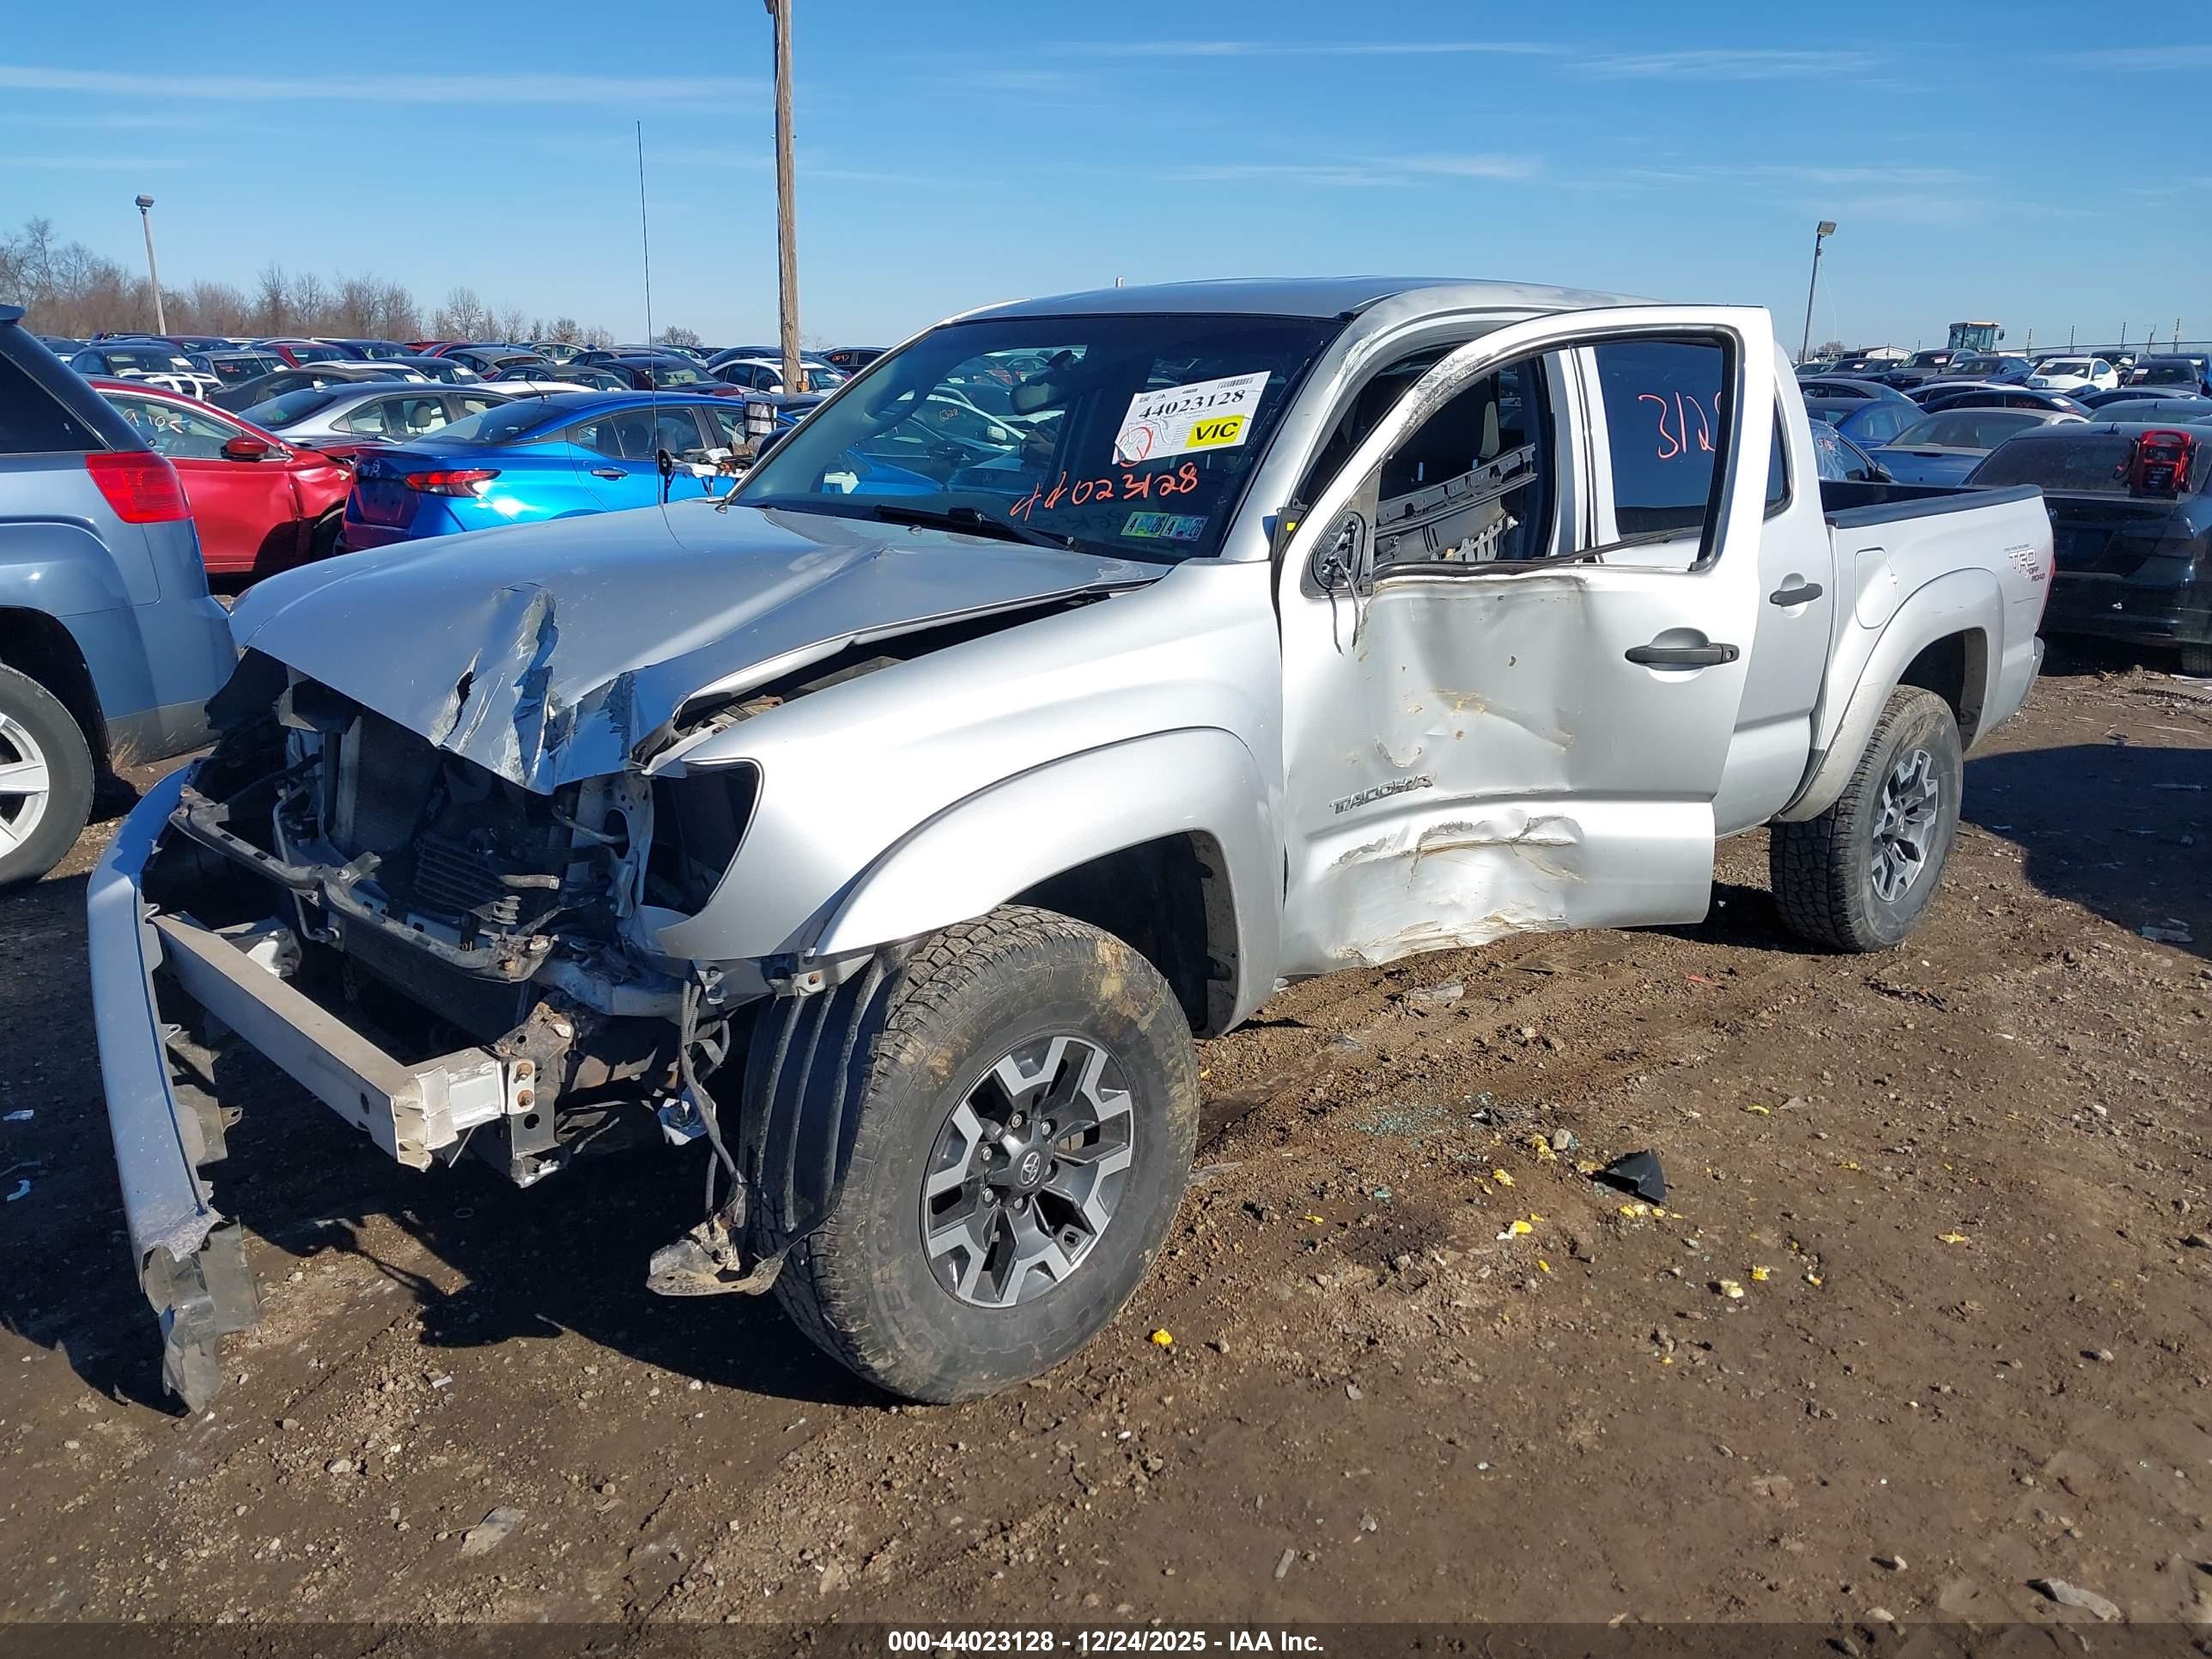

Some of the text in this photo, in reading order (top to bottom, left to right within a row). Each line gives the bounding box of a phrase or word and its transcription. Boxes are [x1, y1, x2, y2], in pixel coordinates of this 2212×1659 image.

[1139, 390, 1246, 418] 44023128
[1196, 422, 1238, 441] VIC
[1009, 461, 1198, 521] 44023128
[2008, 549, 2036, 574] TRD
